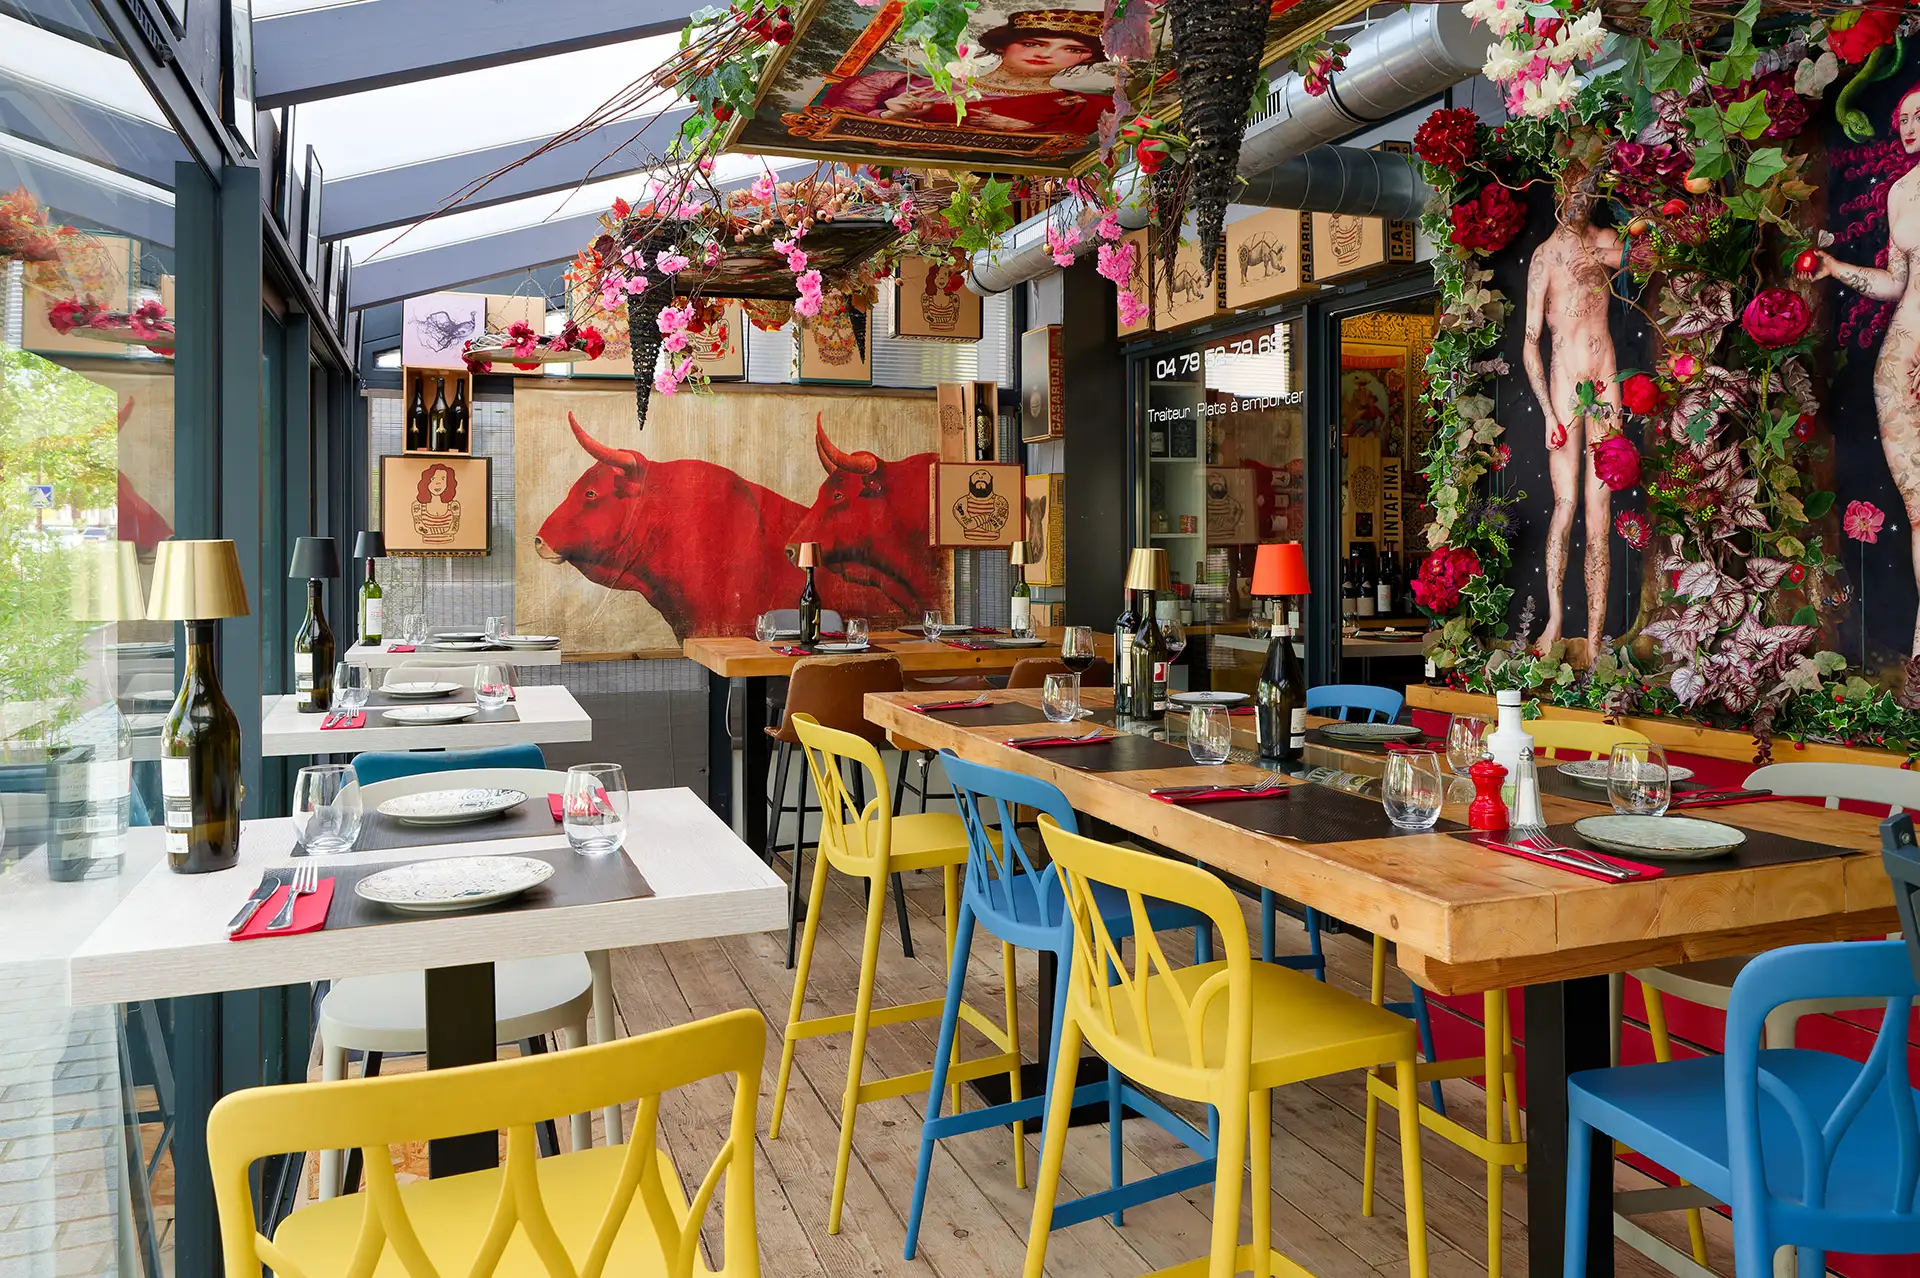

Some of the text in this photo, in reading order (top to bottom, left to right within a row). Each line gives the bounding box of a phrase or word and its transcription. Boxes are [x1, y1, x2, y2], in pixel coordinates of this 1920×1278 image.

[1301, 211, 1311, 284] CASAROJ
[1156, 357, 1177, 379] 04
[1180, 352, 1201, 375] 79
[1230, 339, 1254, 361] 79
[1147, 391, 1304, 423] Traiteur Plats à emporter
[1384, 464, 1399, 547] TINTAFINA
